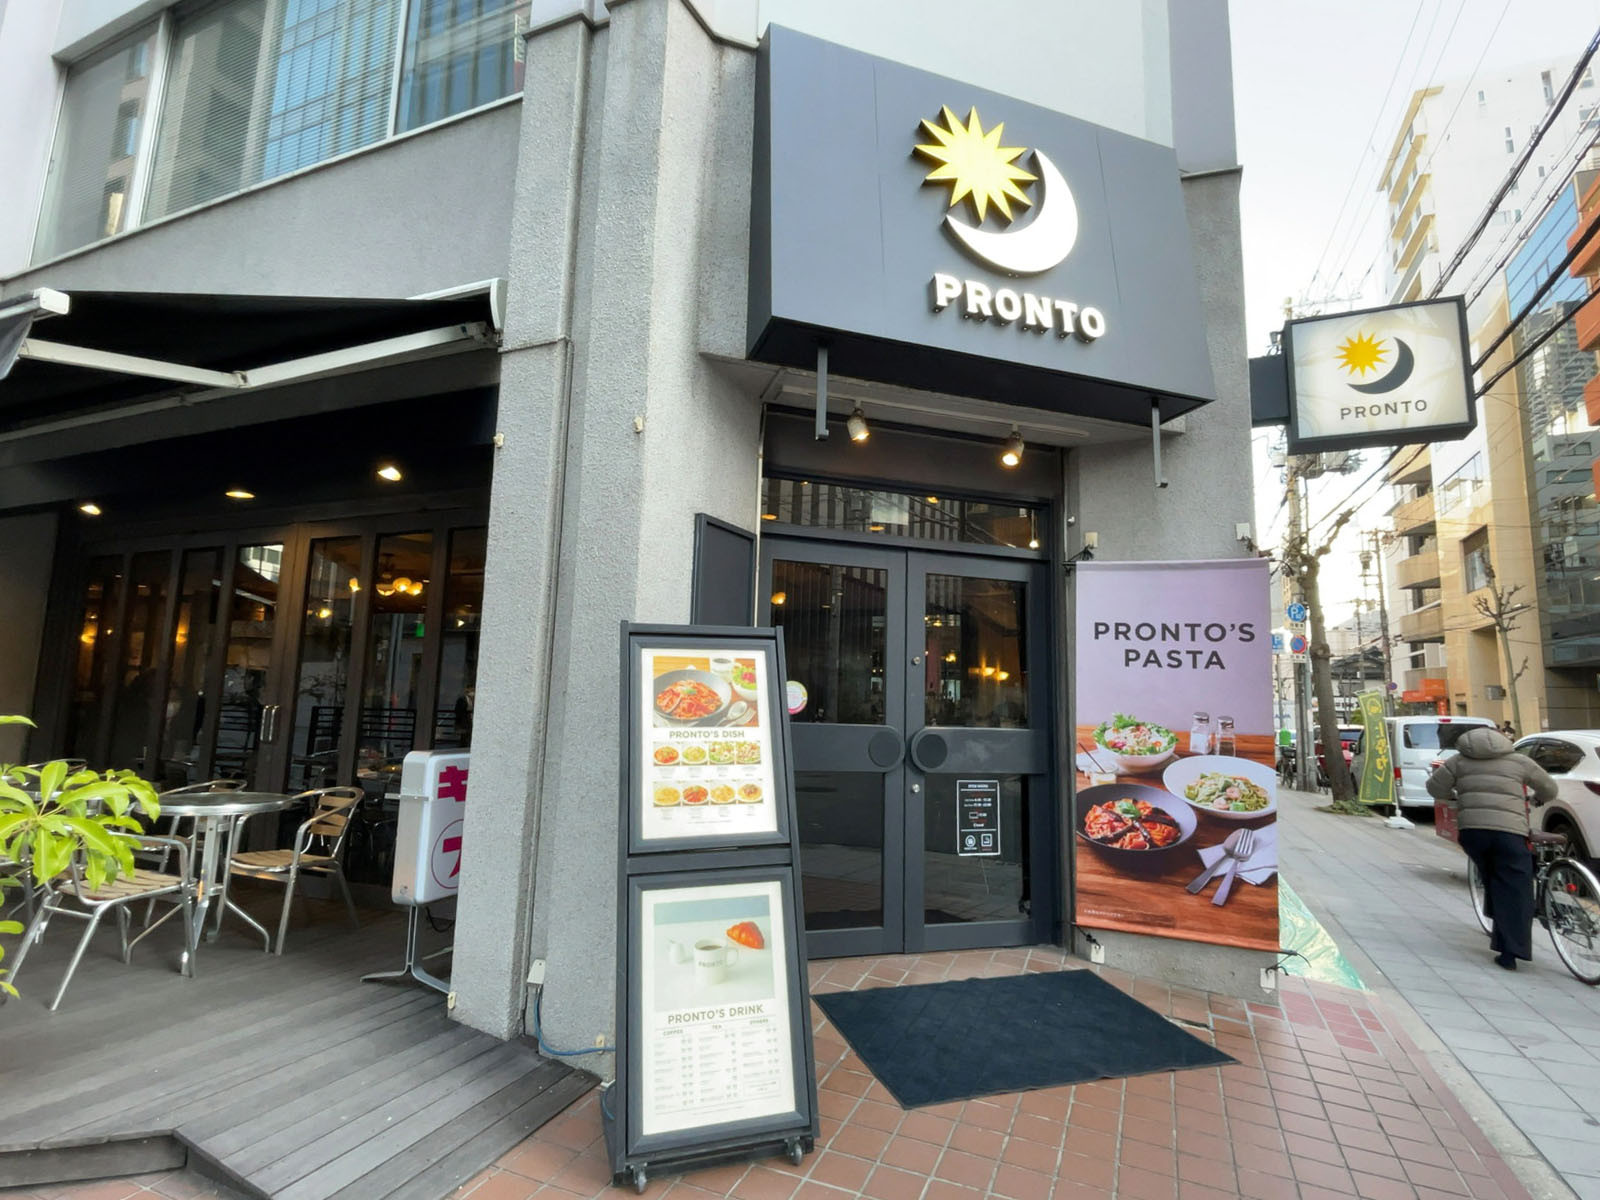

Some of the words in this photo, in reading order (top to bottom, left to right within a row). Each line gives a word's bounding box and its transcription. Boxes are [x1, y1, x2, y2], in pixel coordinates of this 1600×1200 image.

[932, 273, 1106, 339] PRONTO
[1340, 400, 1427, 420] PRONTO
[1093, 622, 1255, 643] PRONTO'S
[1124, 648, 1226, 670] PASTA
[669, 730, 720, 739] PRONTO'S
[722, 730, 745, 738] DISH
[668, 1008, 725, 1025] PRONTO'S
[729, 1003, 764, 1017] DRINK
